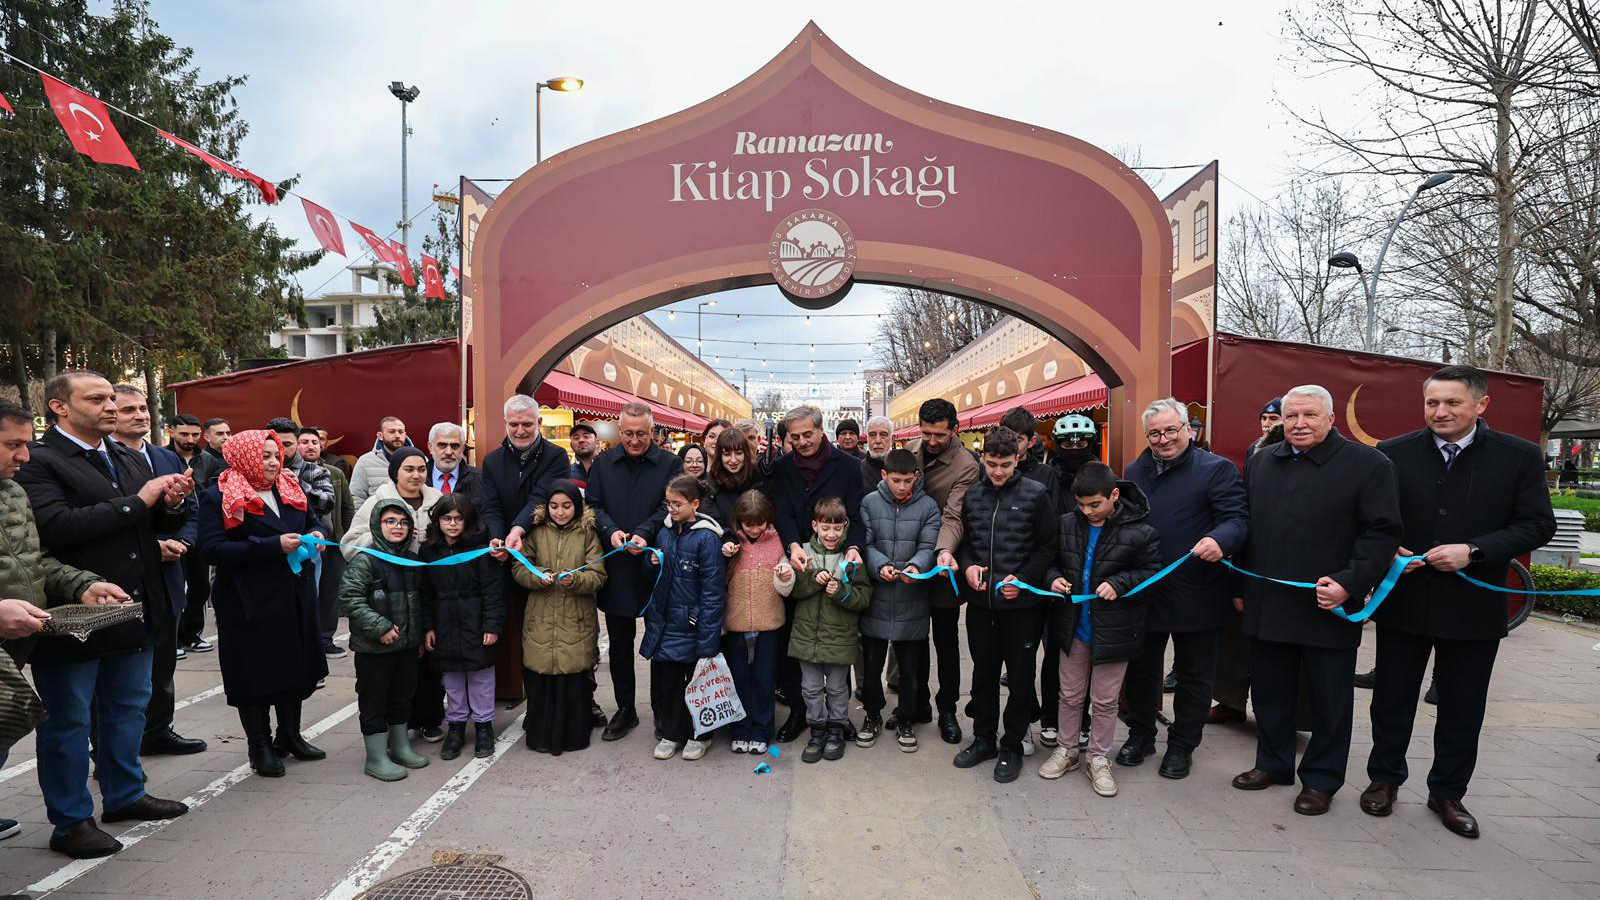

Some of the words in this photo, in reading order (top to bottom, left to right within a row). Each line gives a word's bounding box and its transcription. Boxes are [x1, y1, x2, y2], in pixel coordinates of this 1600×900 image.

[732, 131, 894, 155] Ramazan
[669, 161, 791, 212] Kitap
[802, 155, 959, 209] Sokağı
[787, 212, 838, 228] SAKARYA
